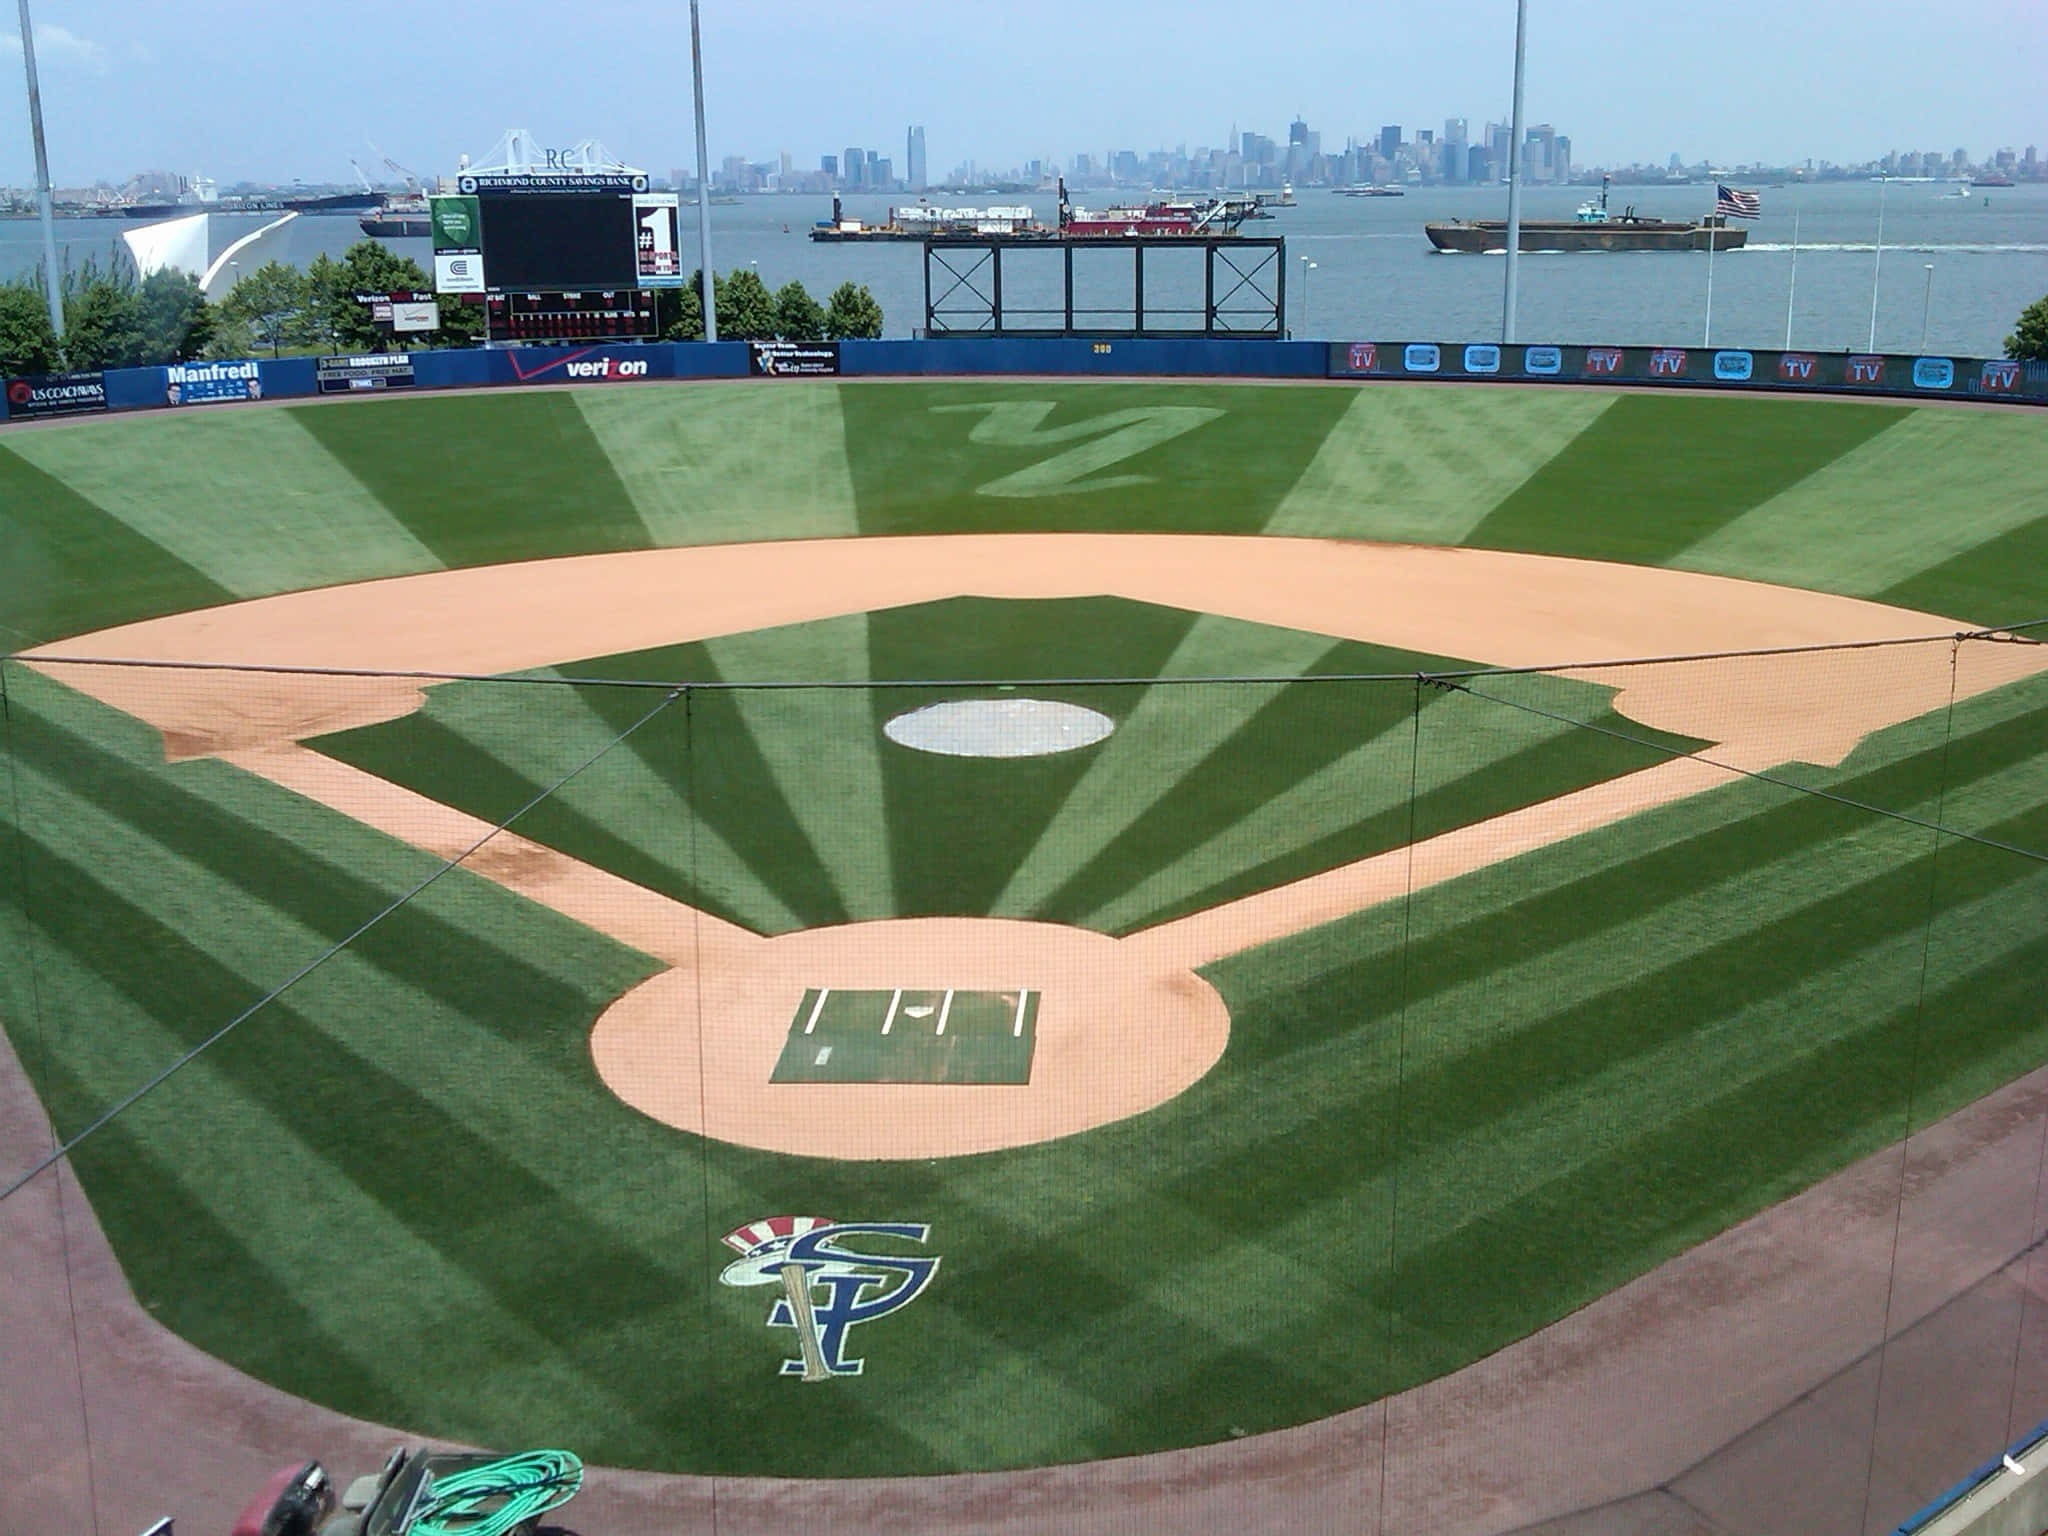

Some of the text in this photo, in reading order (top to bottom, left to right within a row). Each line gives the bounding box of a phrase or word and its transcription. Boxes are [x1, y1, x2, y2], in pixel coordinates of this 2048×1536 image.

[479, 176, 631, 187] RICHMOND COUNTY SAVINGS BANK
[1353, 351, 1372, 367] TV
[1593, 356, 1617, 371] TV
[1656, 356, 1681, 373] TV
[167, 362, 259, 383] Manfredi
[567, 357, 647, 379] verizon
[1786, 362, 1811, 378] TV
[1854, 364, 1879, 381] TV
[1988, 370, 2016, 387] TV
